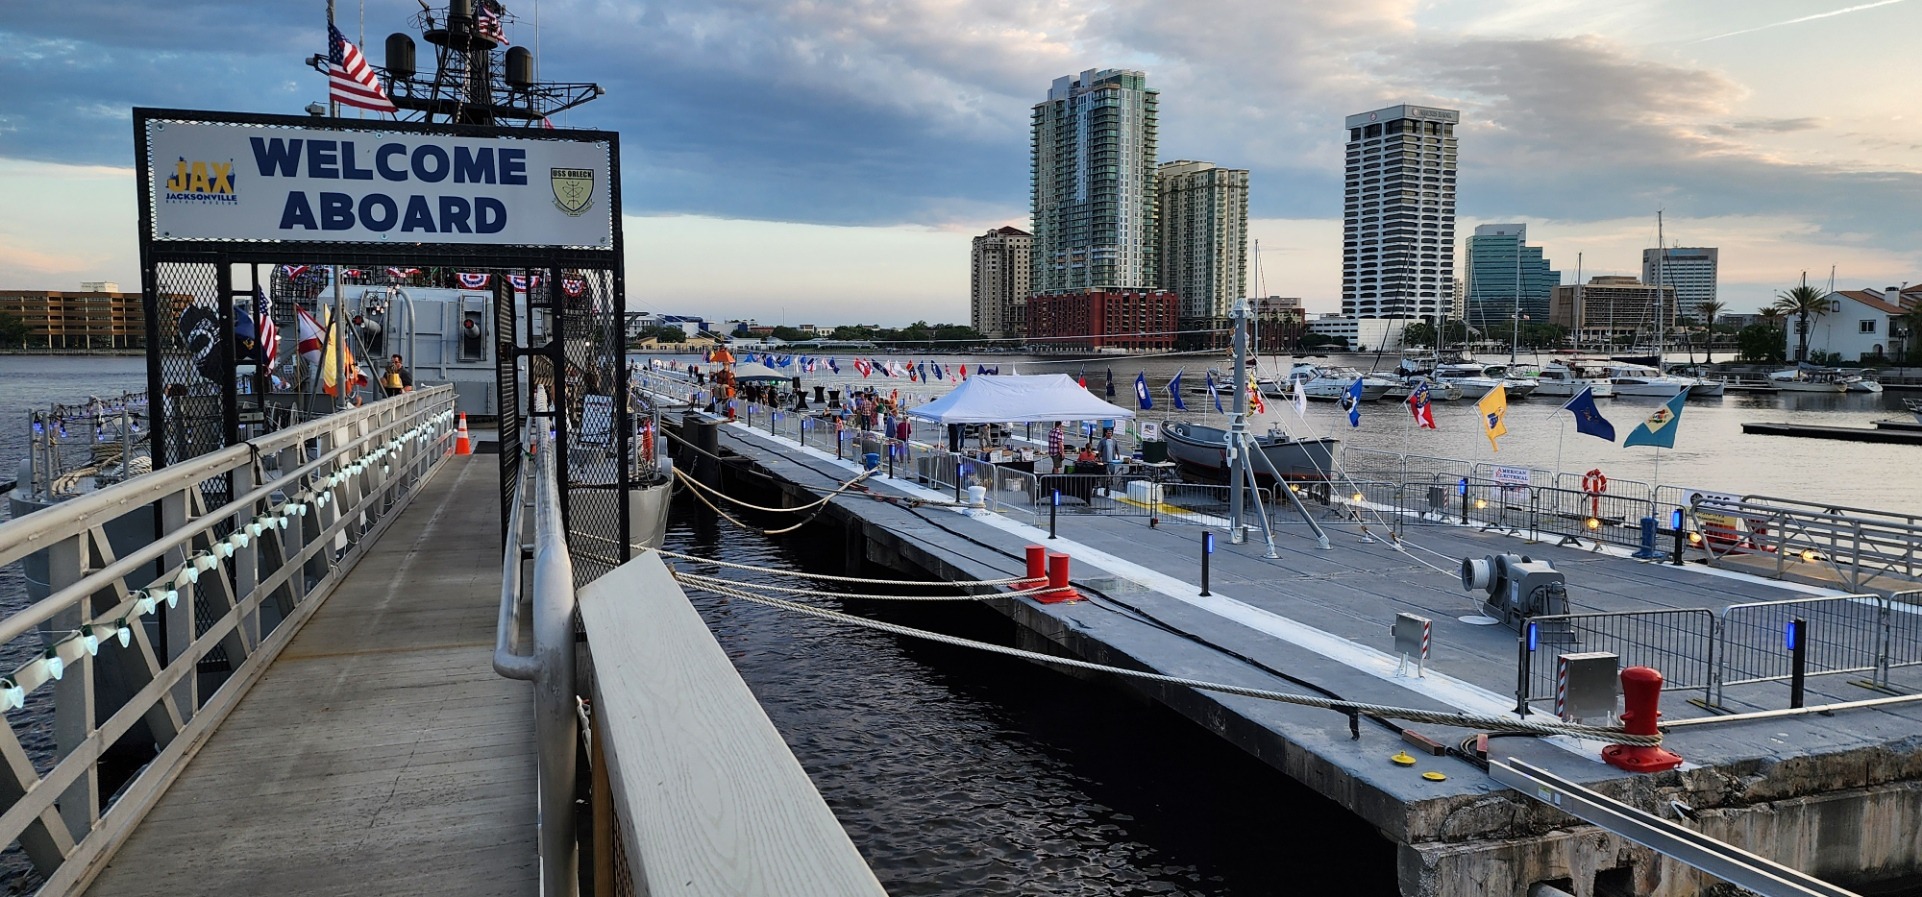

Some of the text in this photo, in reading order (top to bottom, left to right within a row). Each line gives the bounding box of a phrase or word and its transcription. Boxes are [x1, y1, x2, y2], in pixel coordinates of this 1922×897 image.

[167, 161, 234, 193] JAX
[249, 136, 528, 186] WELCOME
[166, 193, 237, 201] JACKSONVILLE
[278, 190, 508, 234] ABOARD
